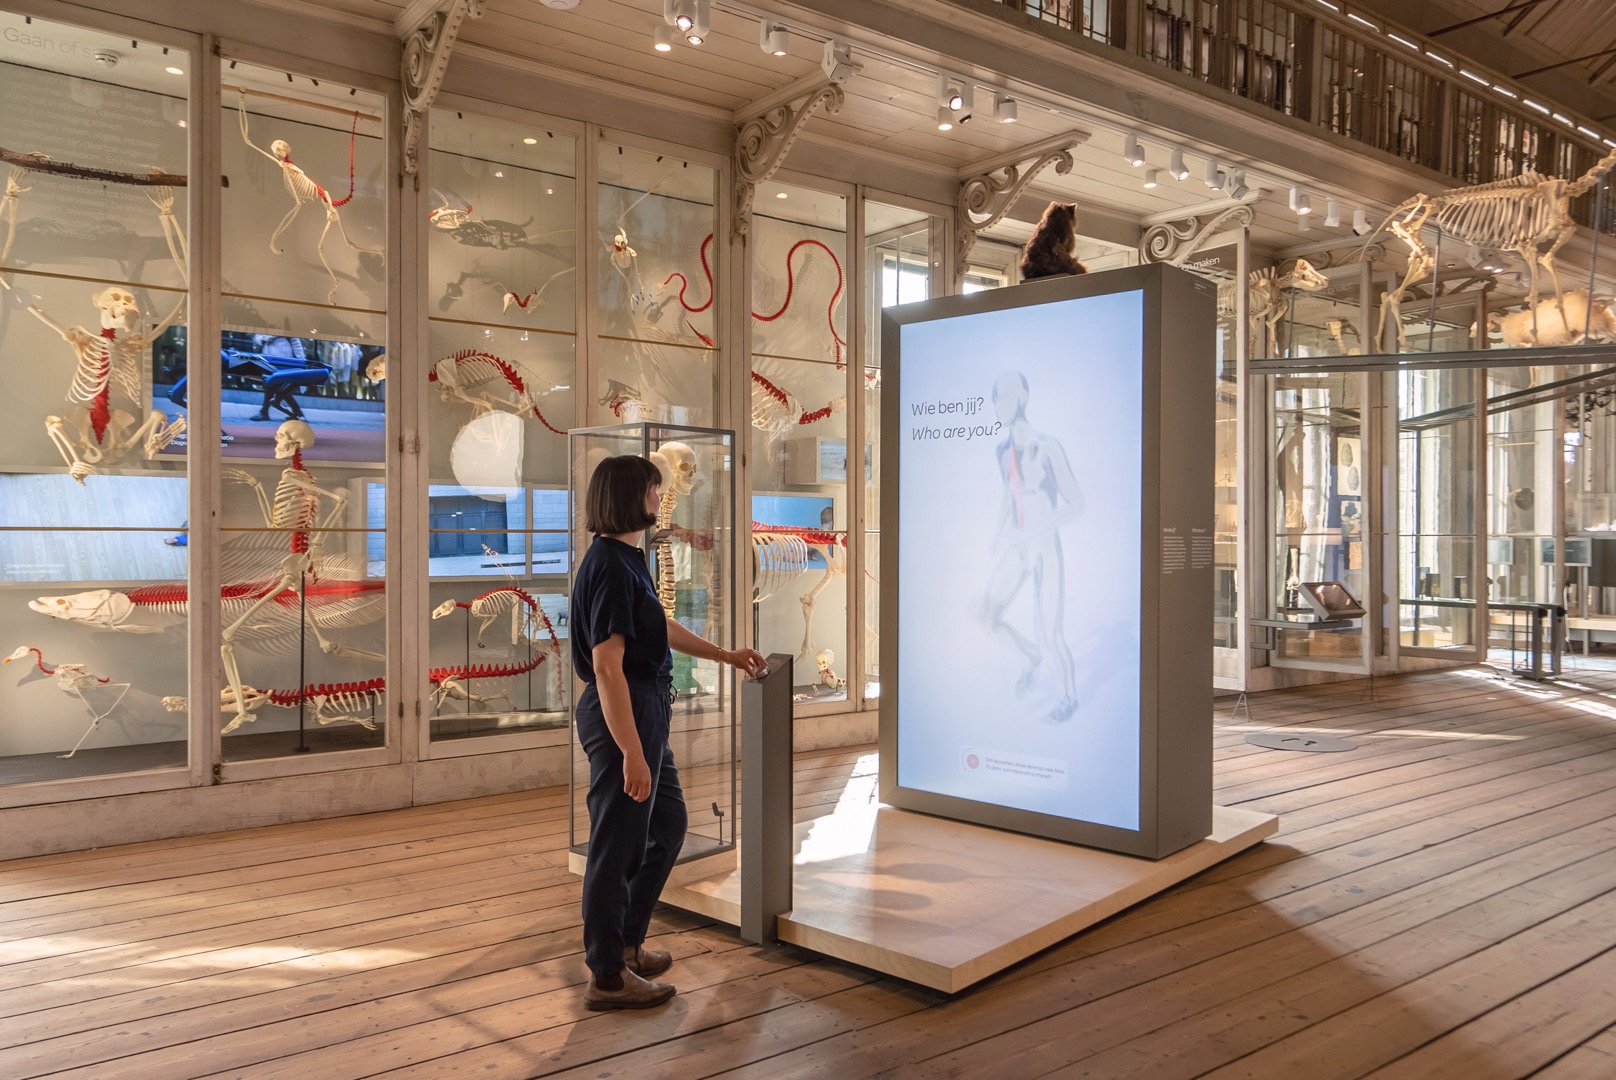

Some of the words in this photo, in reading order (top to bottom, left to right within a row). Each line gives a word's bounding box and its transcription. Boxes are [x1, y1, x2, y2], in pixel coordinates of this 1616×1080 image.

[3, 27, 55, 50] Gaan
[59, 41, 79, 54] of
[1193, 257, 1220, 269] maken
[911, 402, 936, 416] Wie
[938, 400, 964, 414] ben
[965, 396, 985, 416] jij?
[912, 426, 941, 440] Who
[943, 427, 966, 439] are
[966, 421, 1002, 441] you?
